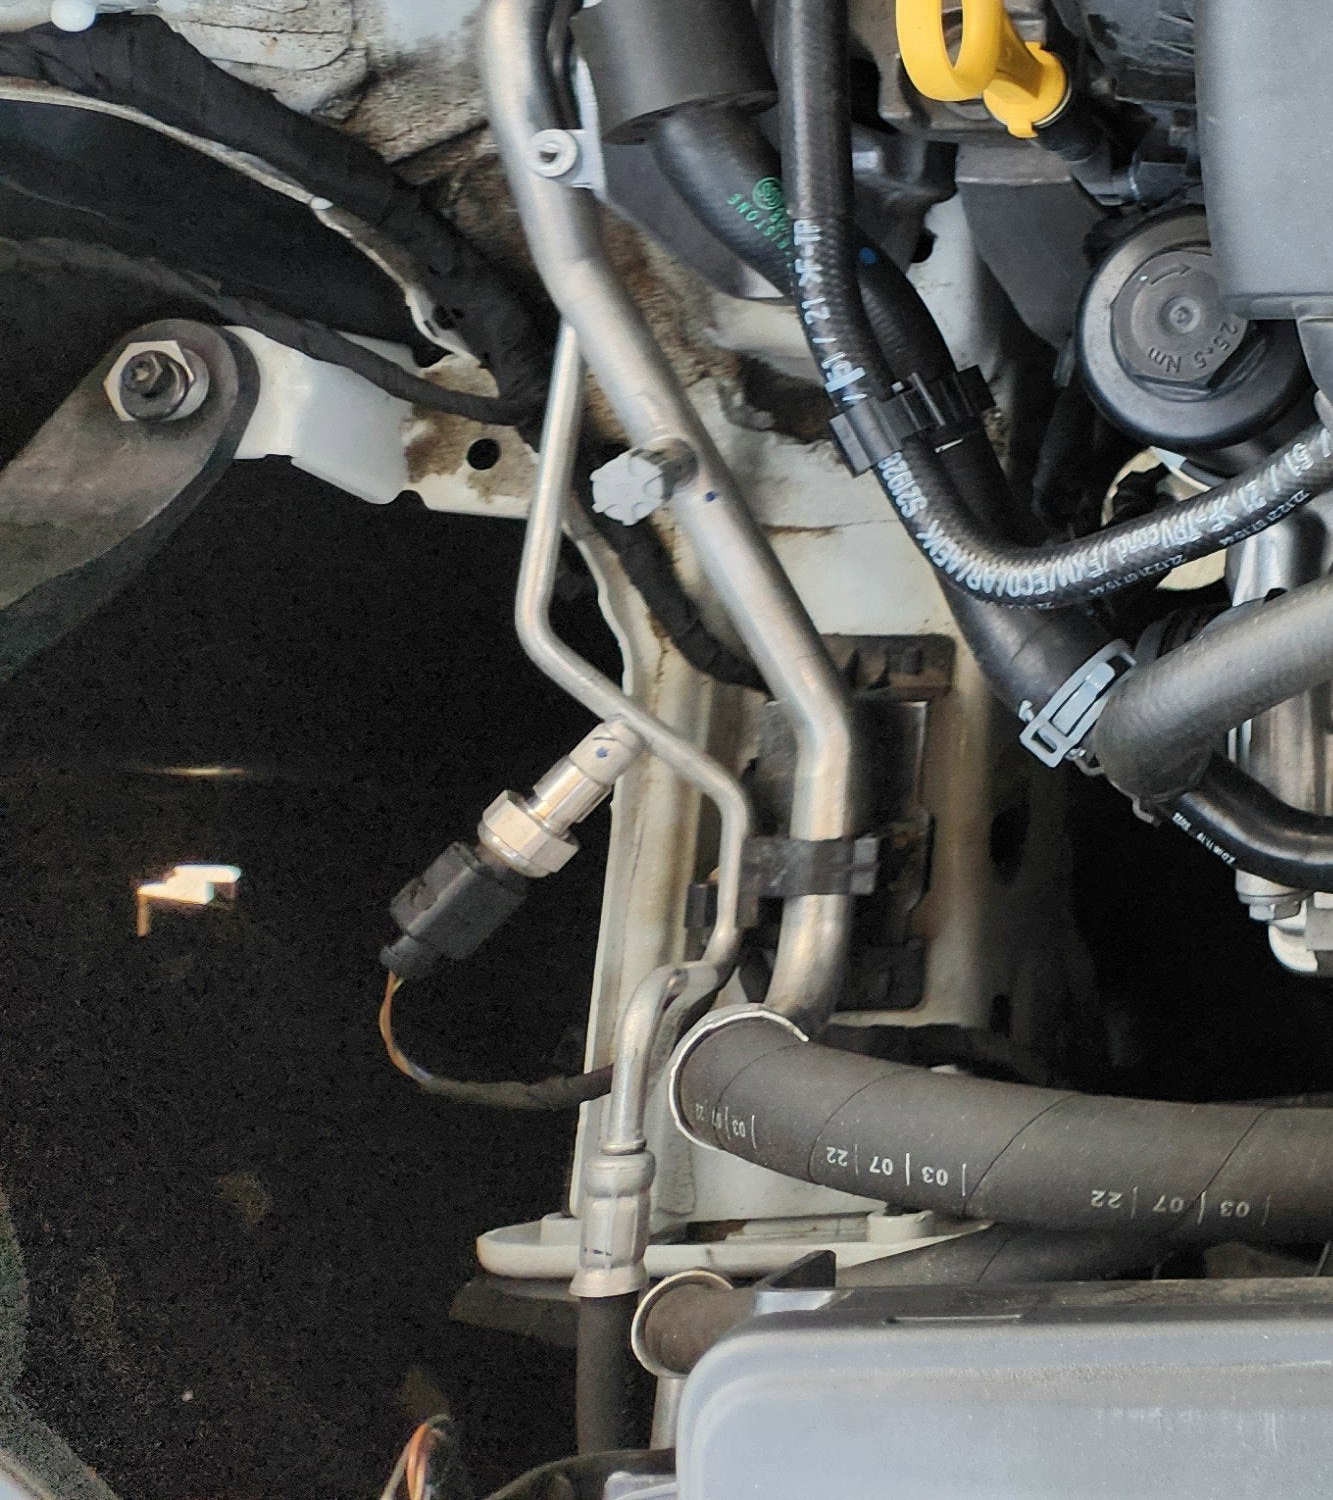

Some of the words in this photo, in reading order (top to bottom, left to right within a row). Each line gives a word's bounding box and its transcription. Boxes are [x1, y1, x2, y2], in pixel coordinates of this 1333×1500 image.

[1147, 346, 1183, 374] Nm
[826, 1147, 849, 1167] 22
[869, 1156, 894, 1176] 07
[922, 1166, 949, 1186] 03
[1090, 1189, 1123, 1208] 22
[1152, 1194, 1184, 1213] 07
[1220, 1200, 1250, 1218] 03
